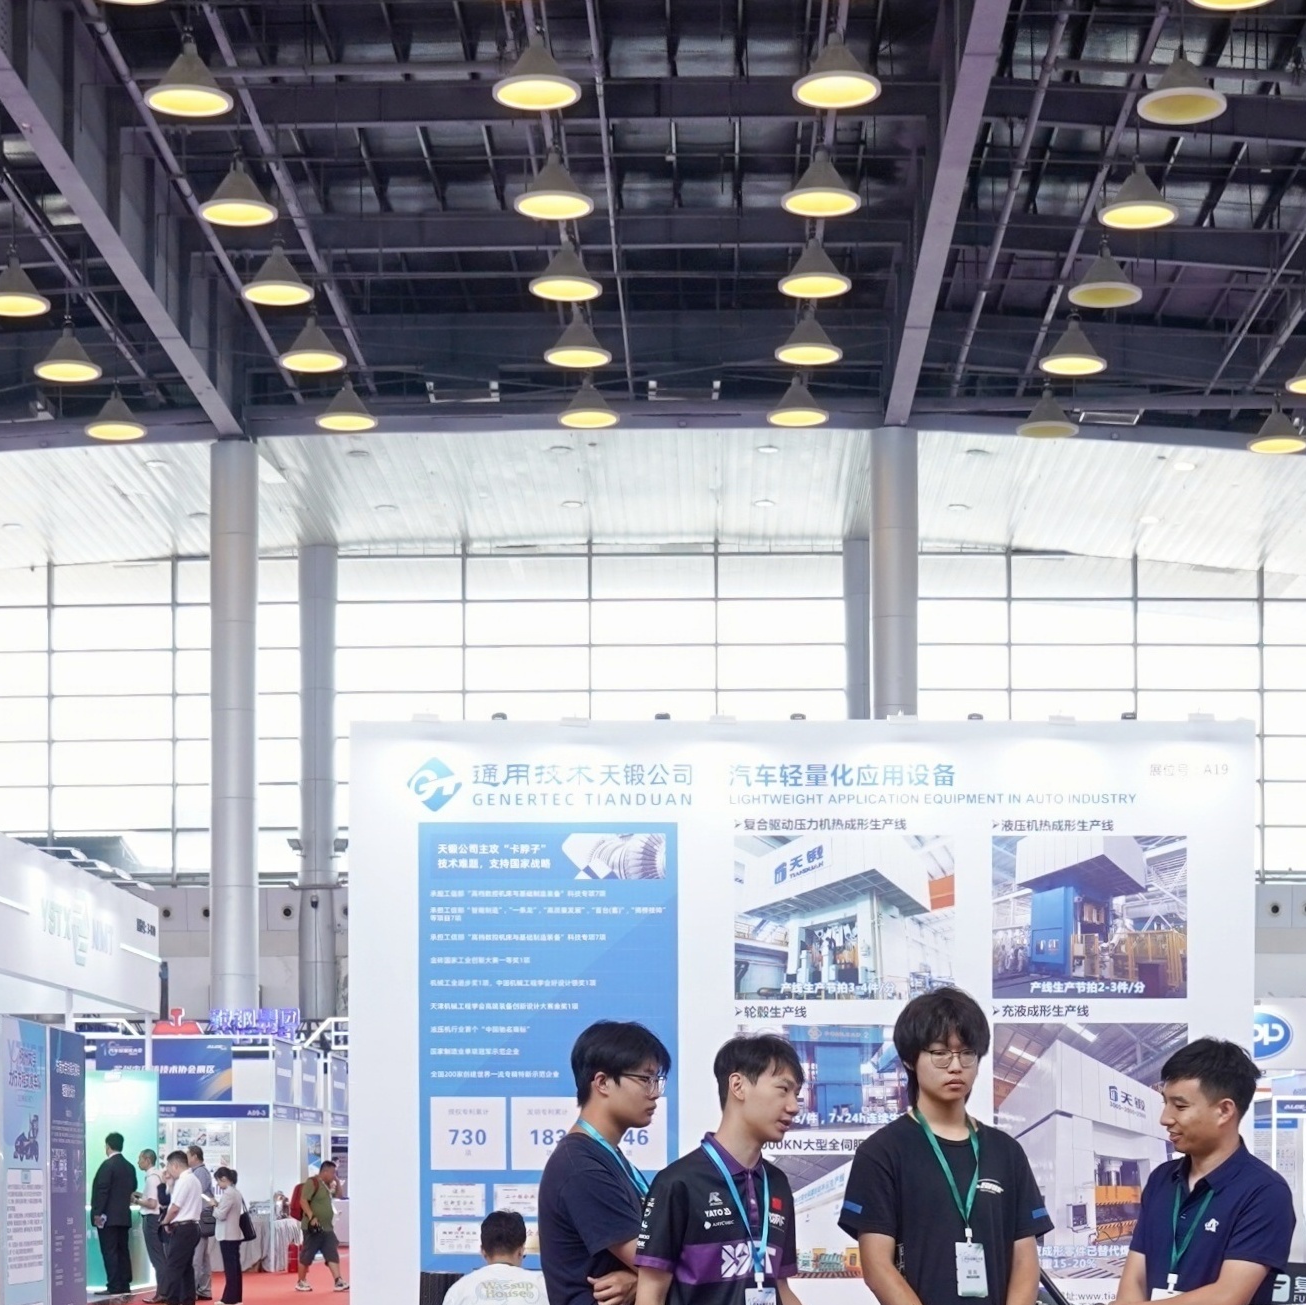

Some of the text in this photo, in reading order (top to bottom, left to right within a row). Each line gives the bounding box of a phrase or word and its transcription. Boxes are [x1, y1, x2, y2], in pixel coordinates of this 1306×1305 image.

[472, 763, 693, 787] 通用技术天锻公司
[729, 763, 955, 788] 汽车轻量化应用设备
[472, 793, 693, 806] GENERTEC TIANDUAN
[730, 793, 1137, 805] LIGHTWEIGHT APPLICATION EQUIPMENT IN AUTO INDUSTRY
[743, 818, 908, 832] 复合驱动压力机热成形生产线
[1001, 818, 1114, 832] 液压机热成形生产线
[780, 980, 896, 995] 产线生产节拍3-4件/分
[1030, 980, 1145, 995] 产线生产节拍2-3件/分
[743, 1005, 808, 1019] 轮毂生产线
[1001, 1004, 1089, 1019] 充液成形生产线
[448, 1129, 487, 1145] 730
[530, 1129, 567, 1145] 183
[623, 1129, 649, 1145] 46
[704, 1209, 723, 1218] YATO
